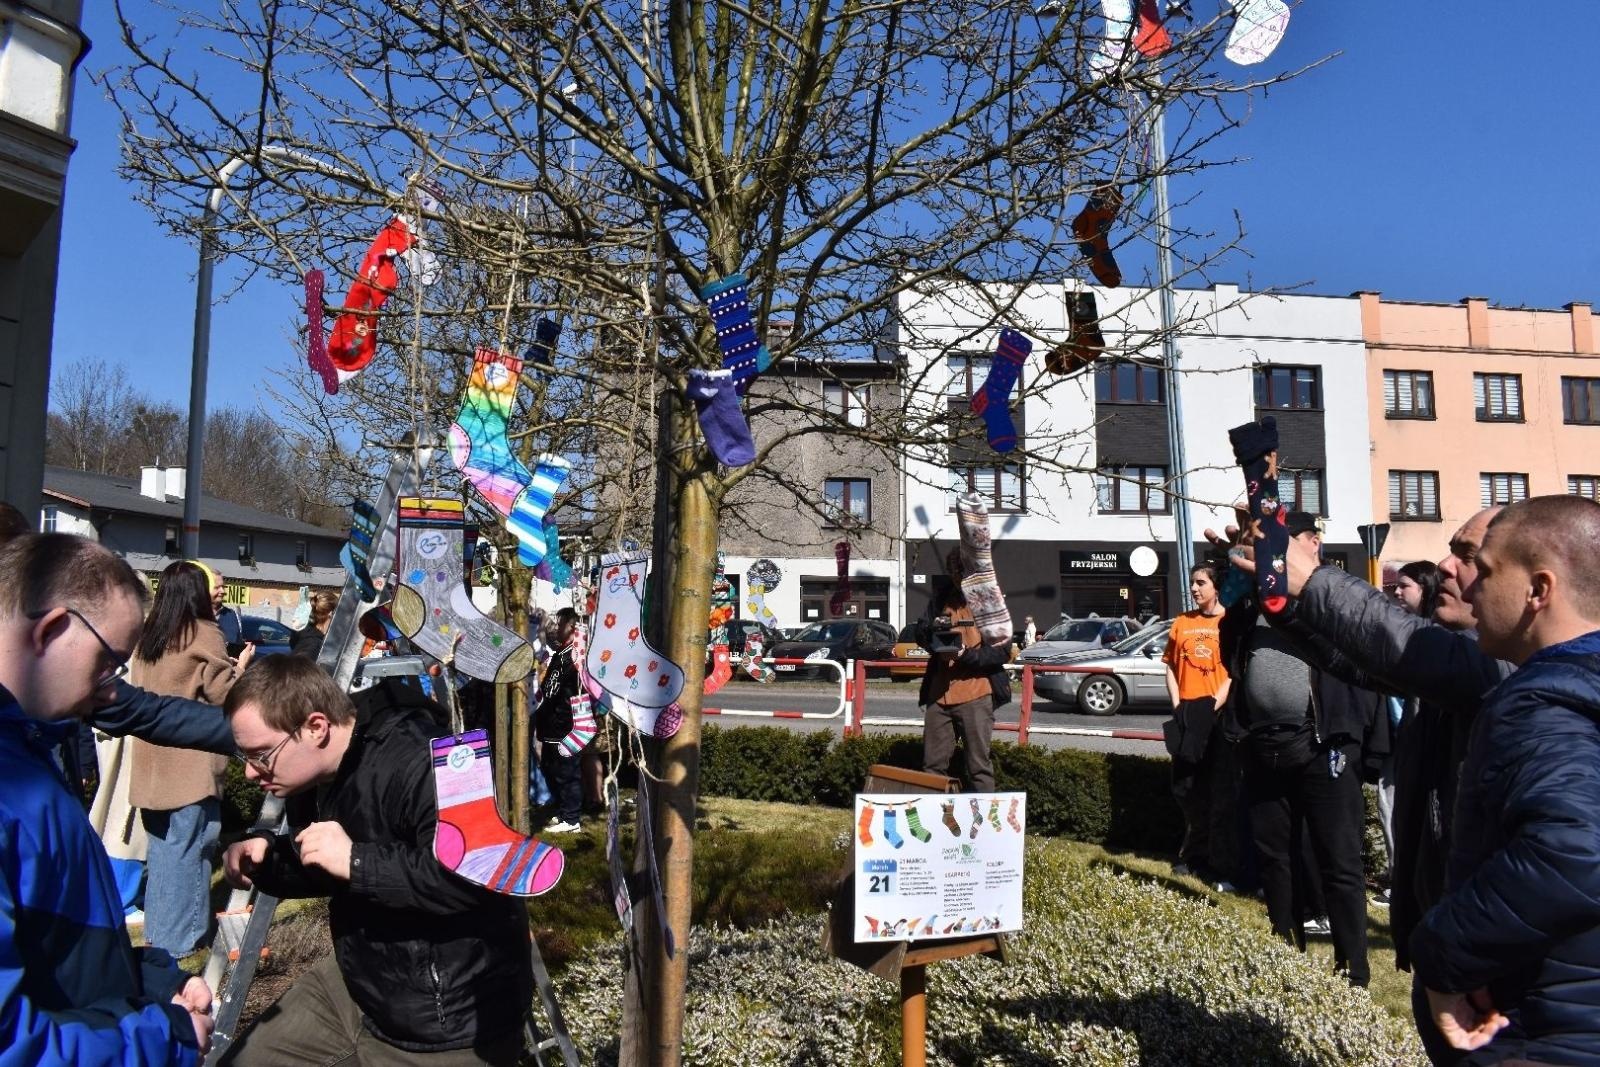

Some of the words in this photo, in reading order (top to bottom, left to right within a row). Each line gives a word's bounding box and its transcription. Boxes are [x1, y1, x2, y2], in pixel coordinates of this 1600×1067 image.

[1091, 553, 1117, 561] SALON
[1071, 561, 1117, 569] FRYZJERSKI
[869, 875, 889, 893] 21
